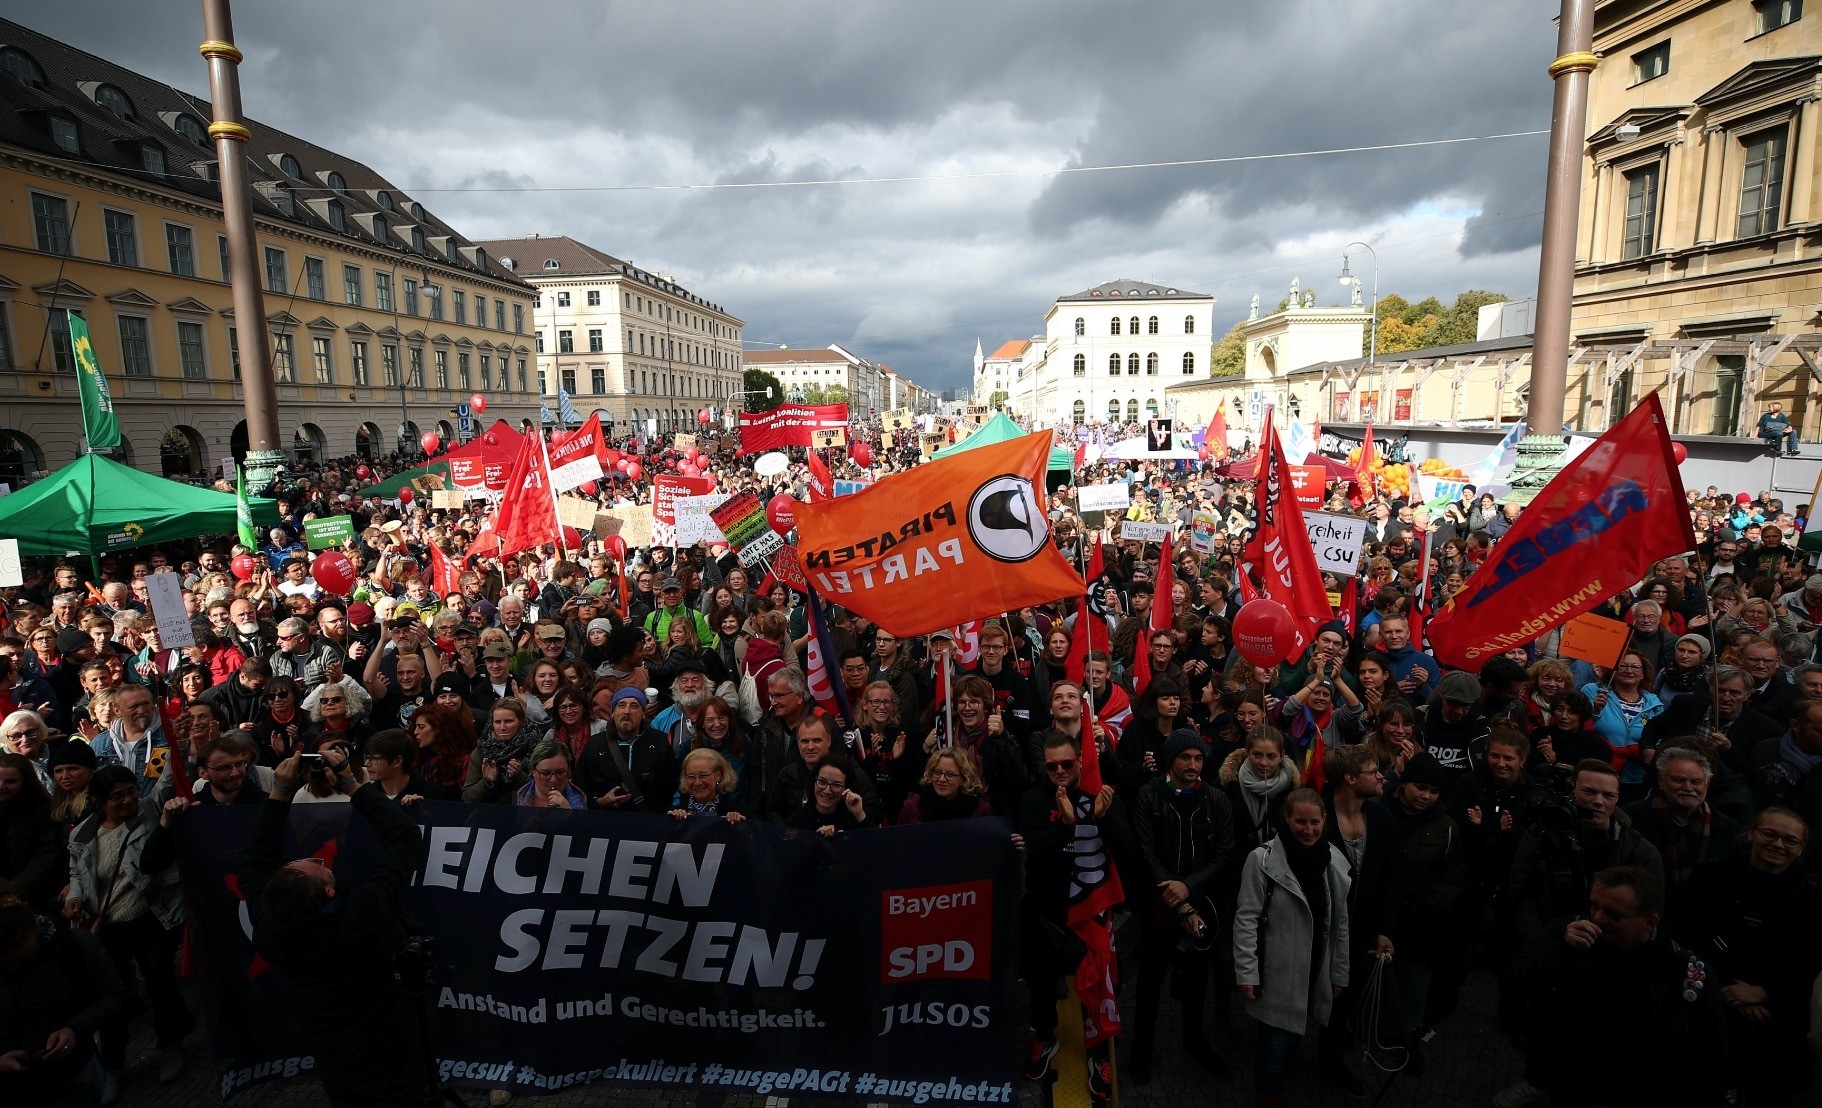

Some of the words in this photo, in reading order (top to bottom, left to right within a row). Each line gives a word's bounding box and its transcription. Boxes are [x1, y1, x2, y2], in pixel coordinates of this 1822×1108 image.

[459, 405, 468, 416] U
[770, 419, 785, 430] mit
[659, 485, 691, 495] Soziale
[741, 543, 760, 559] HATE
[759, 533, 775, 547] HAS
[788, 572, 807, 587] KRA
[1239, 641, 1274, 653] #NoPAG
[1428, 745, 1463, 760] RIOT
[889, 890, 977, 919] Bayern
[494, 909, 827, 991] SETZEN!
[888, 940, 975, 978] SPD
[437, 986, 547, 1024] Anstand
[556, 993, 613, 1021] und
[620, 996, 826, 1033] Gerechtigkeit.
[221, 1055, 316, 1100] #ausge
[436, 1055, 515, 1083] gecsut
[701, 1062, 851, 1094] #ausgePAGt
[854, 1072, 1012, 1104] #ausgehetzt
